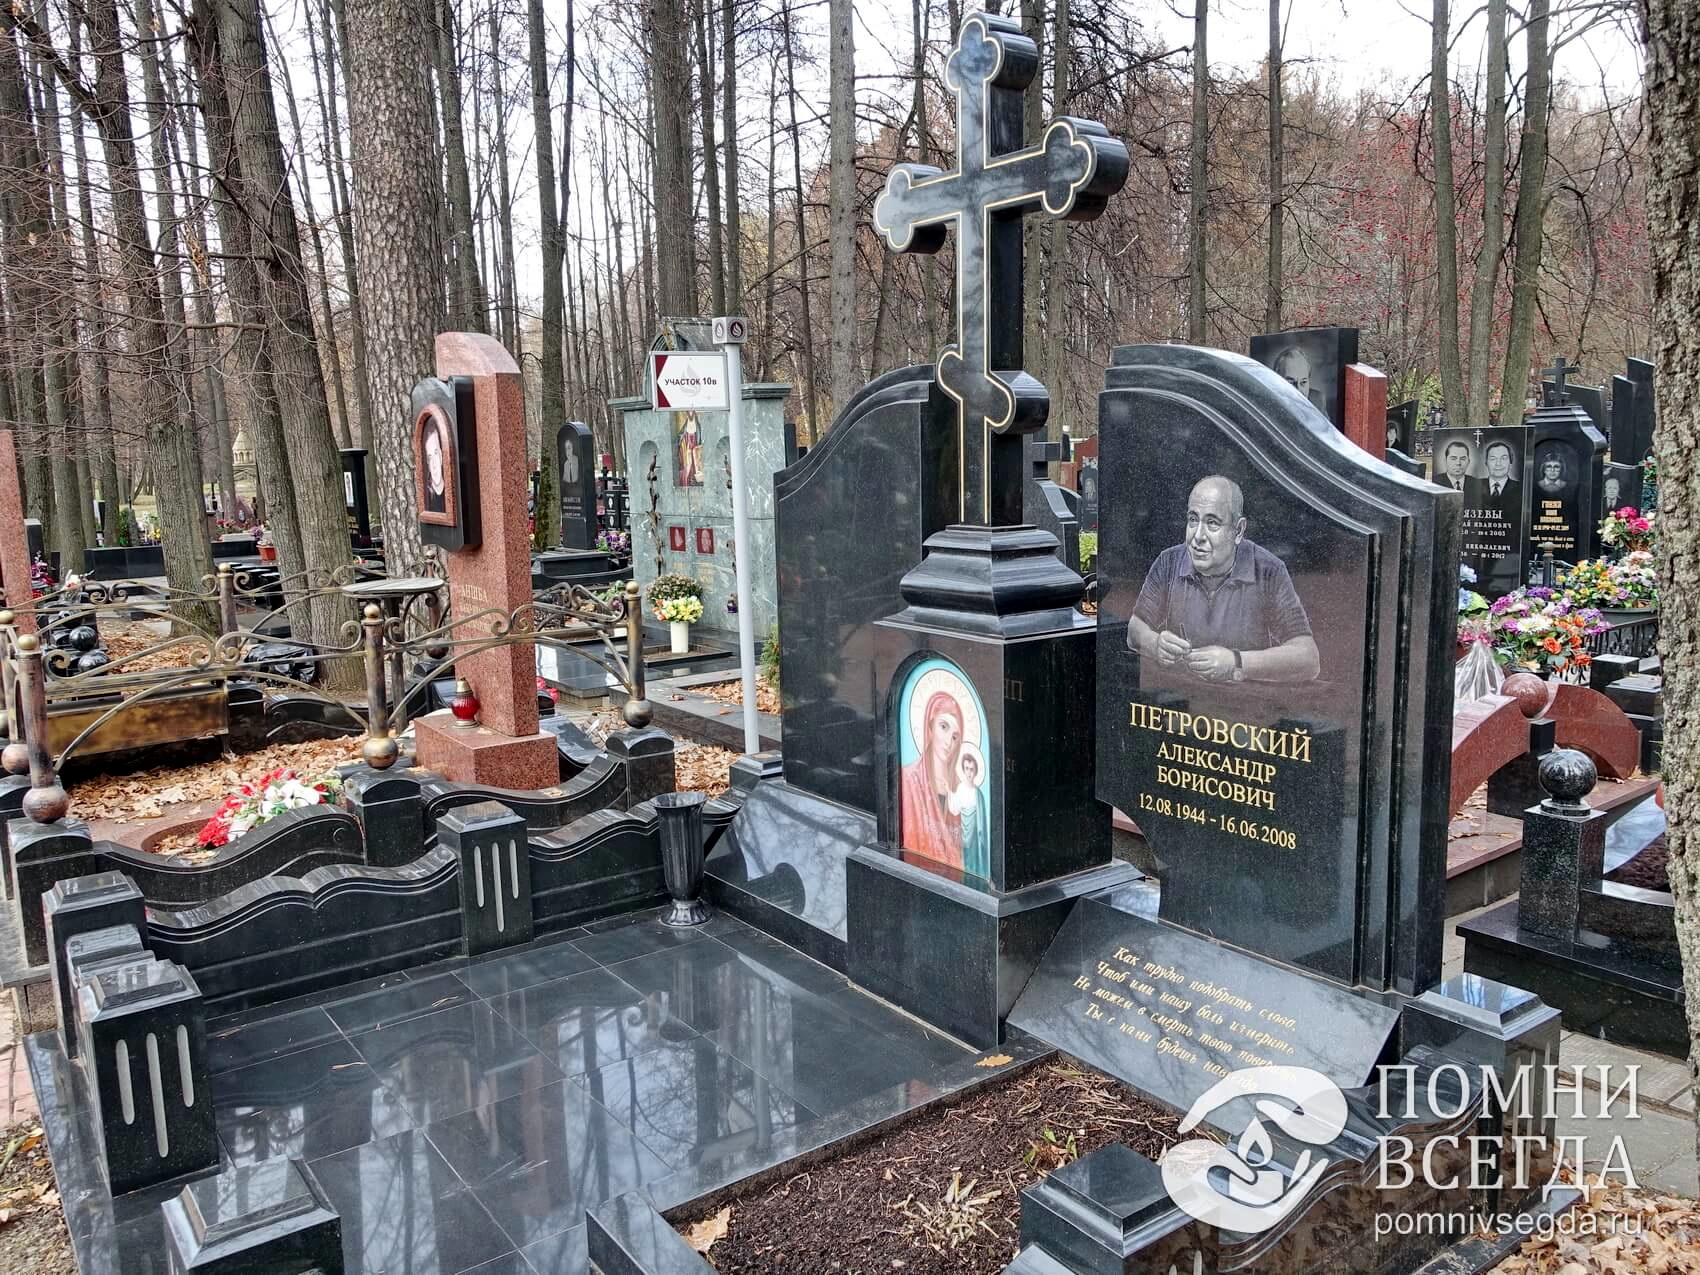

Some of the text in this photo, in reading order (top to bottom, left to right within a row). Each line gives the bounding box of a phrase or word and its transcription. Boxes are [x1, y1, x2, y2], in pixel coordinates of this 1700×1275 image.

[665, 378, 701, 386] УЧАСТОК
[1463, 509, 1503, 519] ЯЗЕВЫ
[1130, 702, 1312, 763] ПЕТРОВСКИЙ
[1156, 741, 1277, 785] АЛЕКСАНДР
[1156, 765, 1276, 811] БОРИСОВИЧ
[1139, 792, 1206, 825] 12.08.1944
[1220, 814, 1297, 849] 16.06.2008
[1097, 961, 1131, 983] Чтоб
[1129, 979, 1155, 996] ими
[1159, 991, 1192, 1014] нашу
[1196, 1004, 1224, 1025] боль
[1113, 946, 1140, 966] Как
[1143, 962, 1185, 984] трудно
[1188, 980, 1253, 1012] подобрать
[1073, 975, 1091, 991] Не
[1092, 987, 1134, 1010] можем
[1137, 1006, 1147, 1016] в
[1150, 1012, 1193, 1038] смерть
[1198, 1033, 1233, 1054] твою
[1085, 1002, 1197, 1064] Ты с нами будешь
